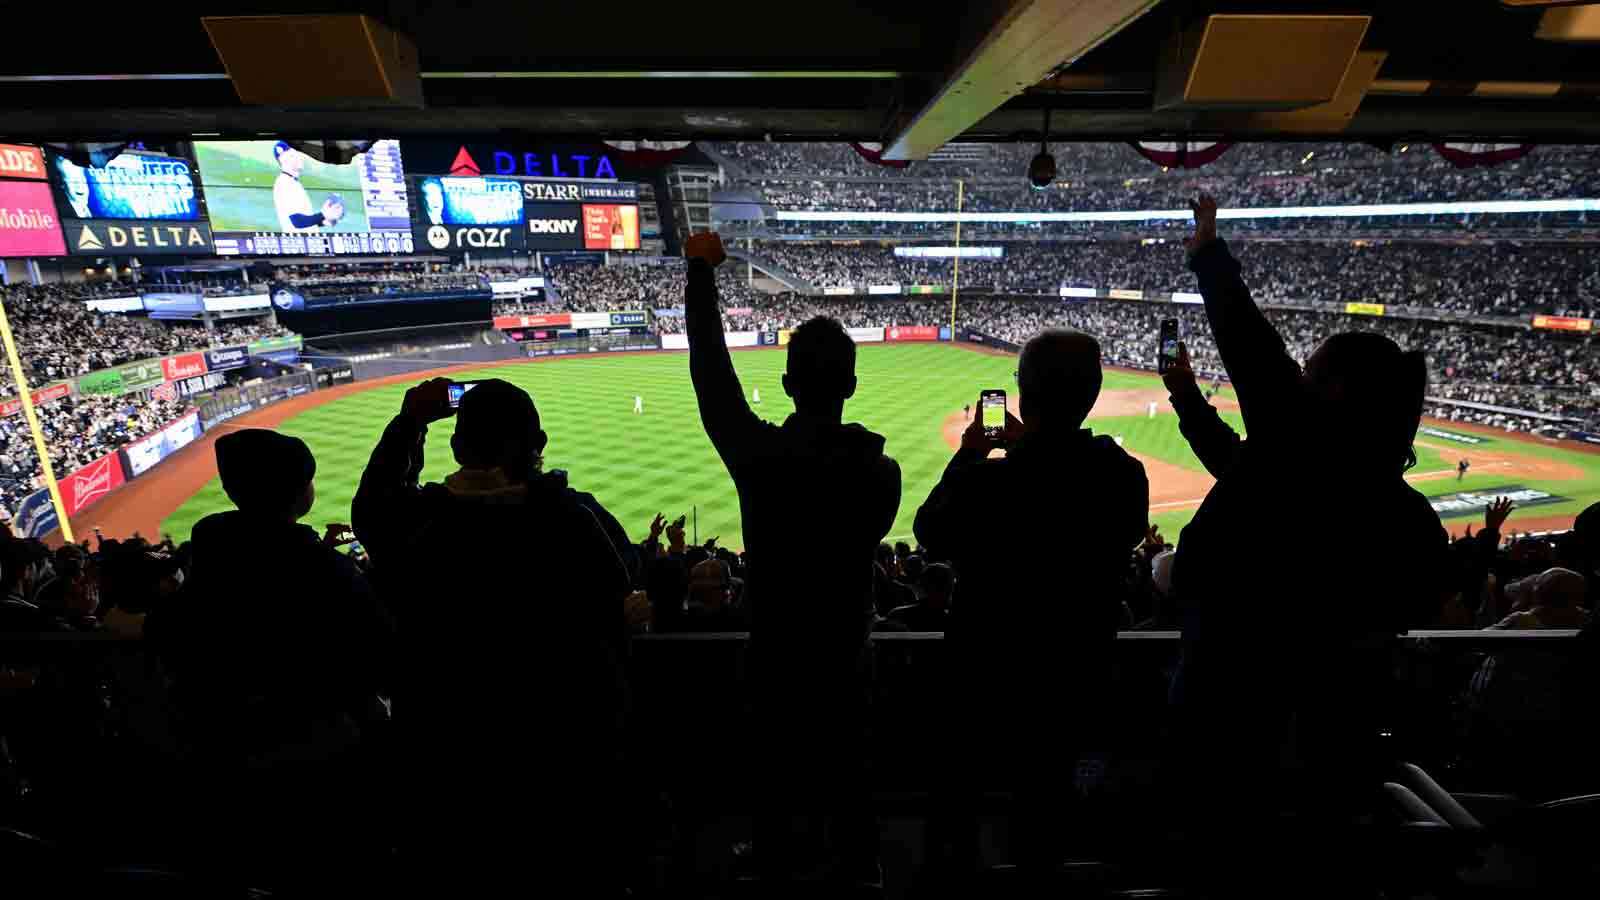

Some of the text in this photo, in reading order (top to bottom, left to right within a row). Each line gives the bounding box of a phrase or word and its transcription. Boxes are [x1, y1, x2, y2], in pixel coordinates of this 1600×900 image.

[494, 152, 617, 178] DELTA
[524, 184, 579, 200] STARR
[584, 186, 636, 197] INSURANCE
[529, 220, 578, 233] DKNY
[108, 226, 205, 247] DELTA
[456, 228, 512, 248] razr
